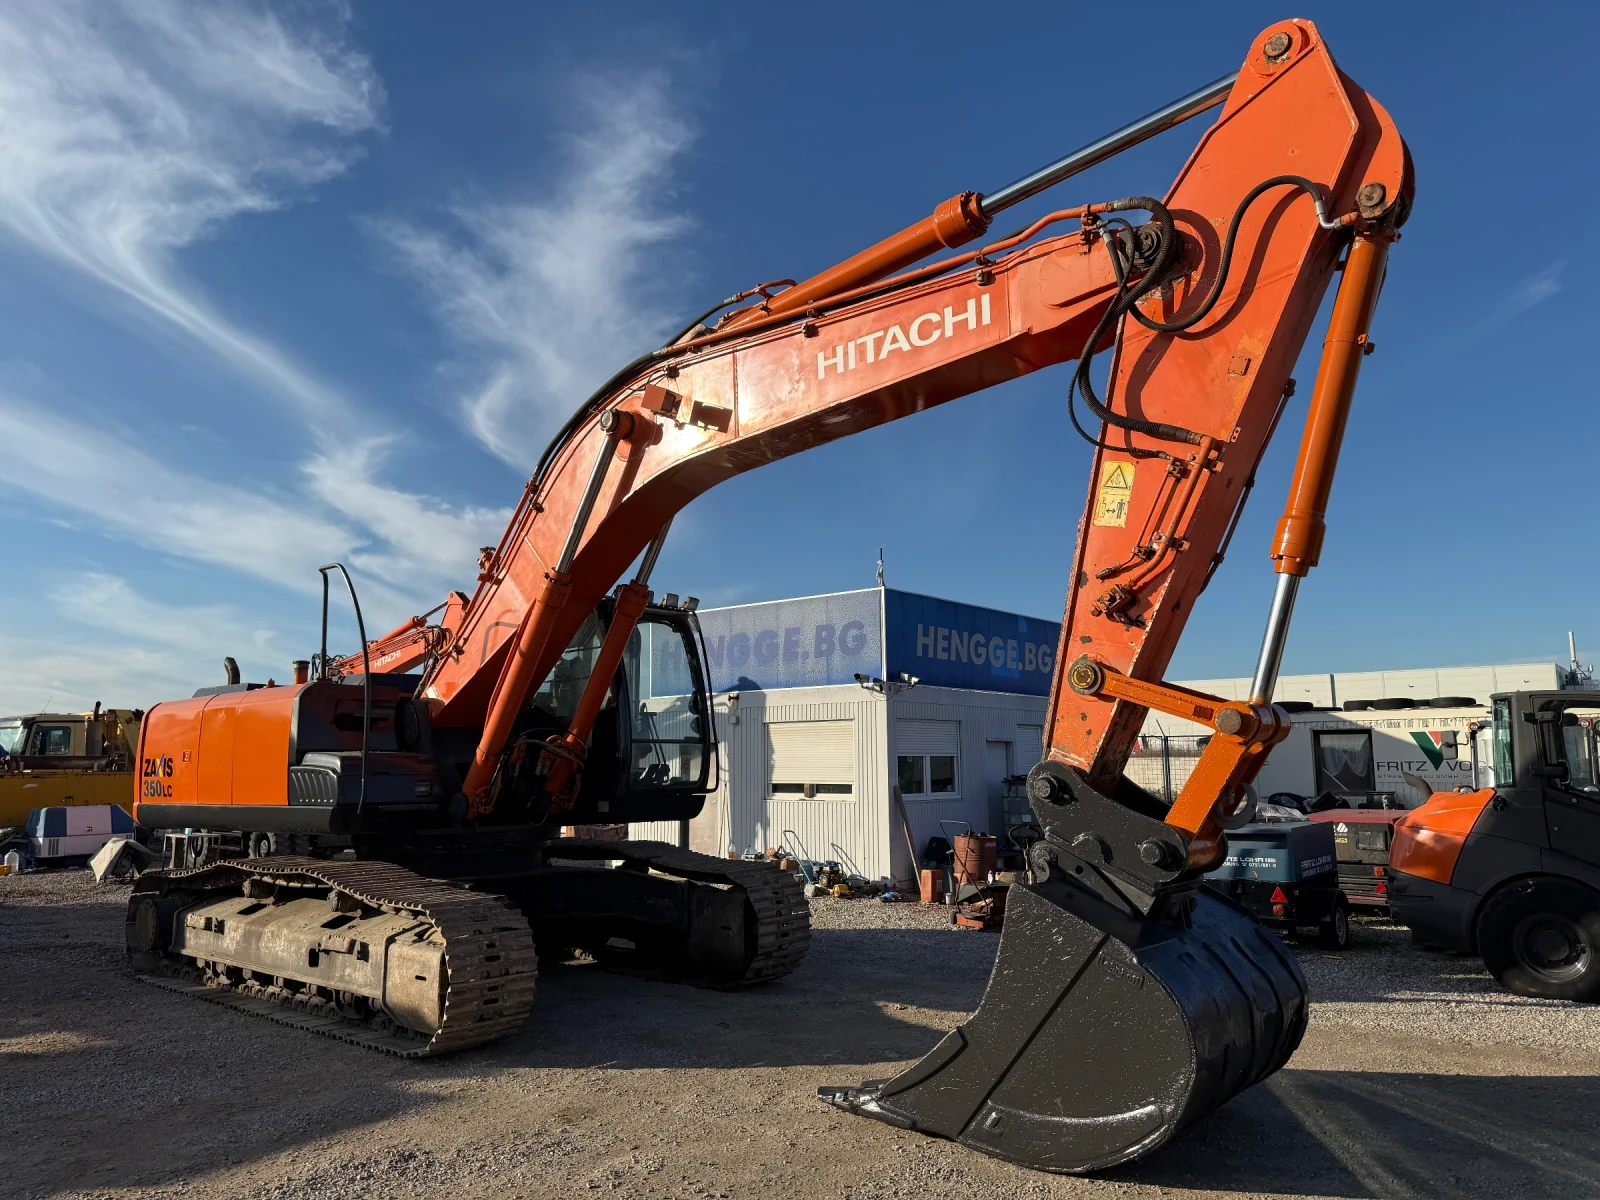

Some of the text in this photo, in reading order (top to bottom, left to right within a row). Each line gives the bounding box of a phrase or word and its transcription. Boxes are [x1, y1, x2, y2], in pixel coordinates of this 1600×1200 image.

[817, 293, 991, 380] HITACHI
[374, 649, 402, 669] HITACHI
[660, 620, 867, 674] HNGGE.BG
[916, 623, 1053, 674] HENGGE.BG
[144, 753, 173, 778] ZAXIS
[1377, 761, 1427, 772] FRITZ
